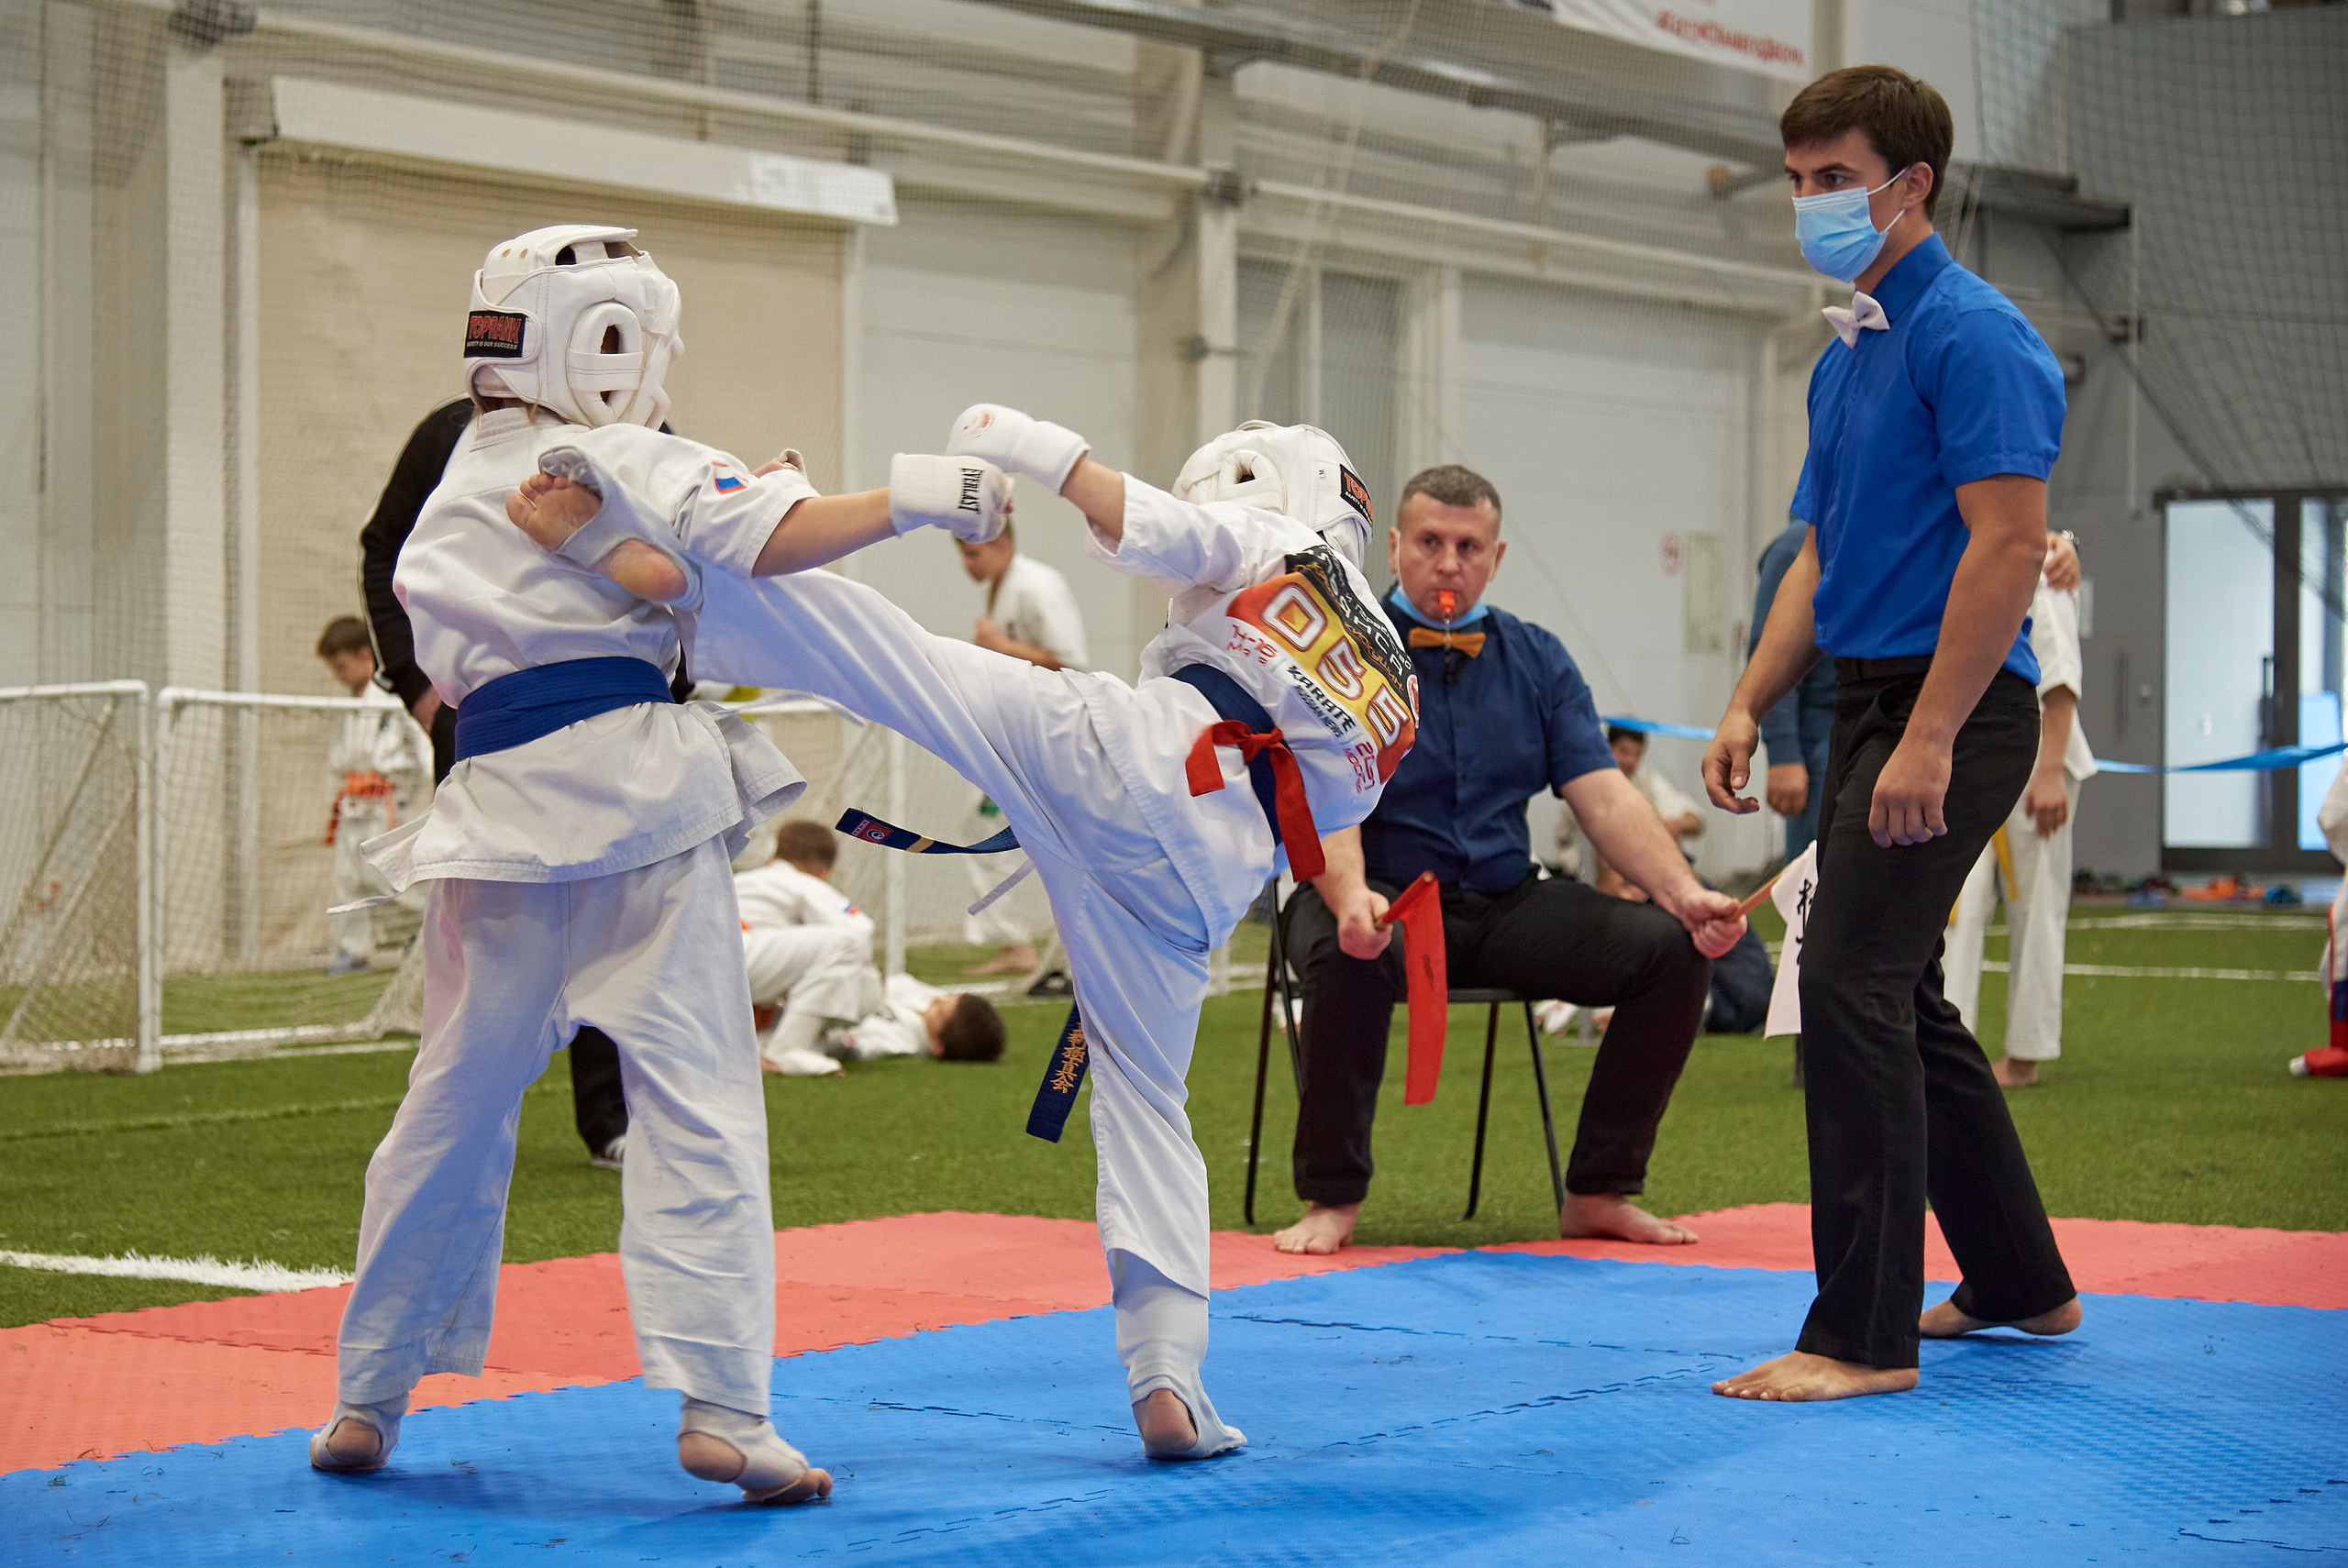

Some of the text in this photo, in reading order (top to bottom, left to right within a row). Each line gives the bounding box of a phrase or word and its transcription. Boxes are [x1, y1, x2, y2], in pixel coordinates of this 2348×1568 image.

[468, 315, 522, 344] TOPRANK
[493, 341, 518, 350] SUCCESS
[958, 467, 984, 514] EVERLAST
[1287, 666, 1356, 733] KARATE
[1296, 684, 1344, 738] RUSSIAN NEWS
